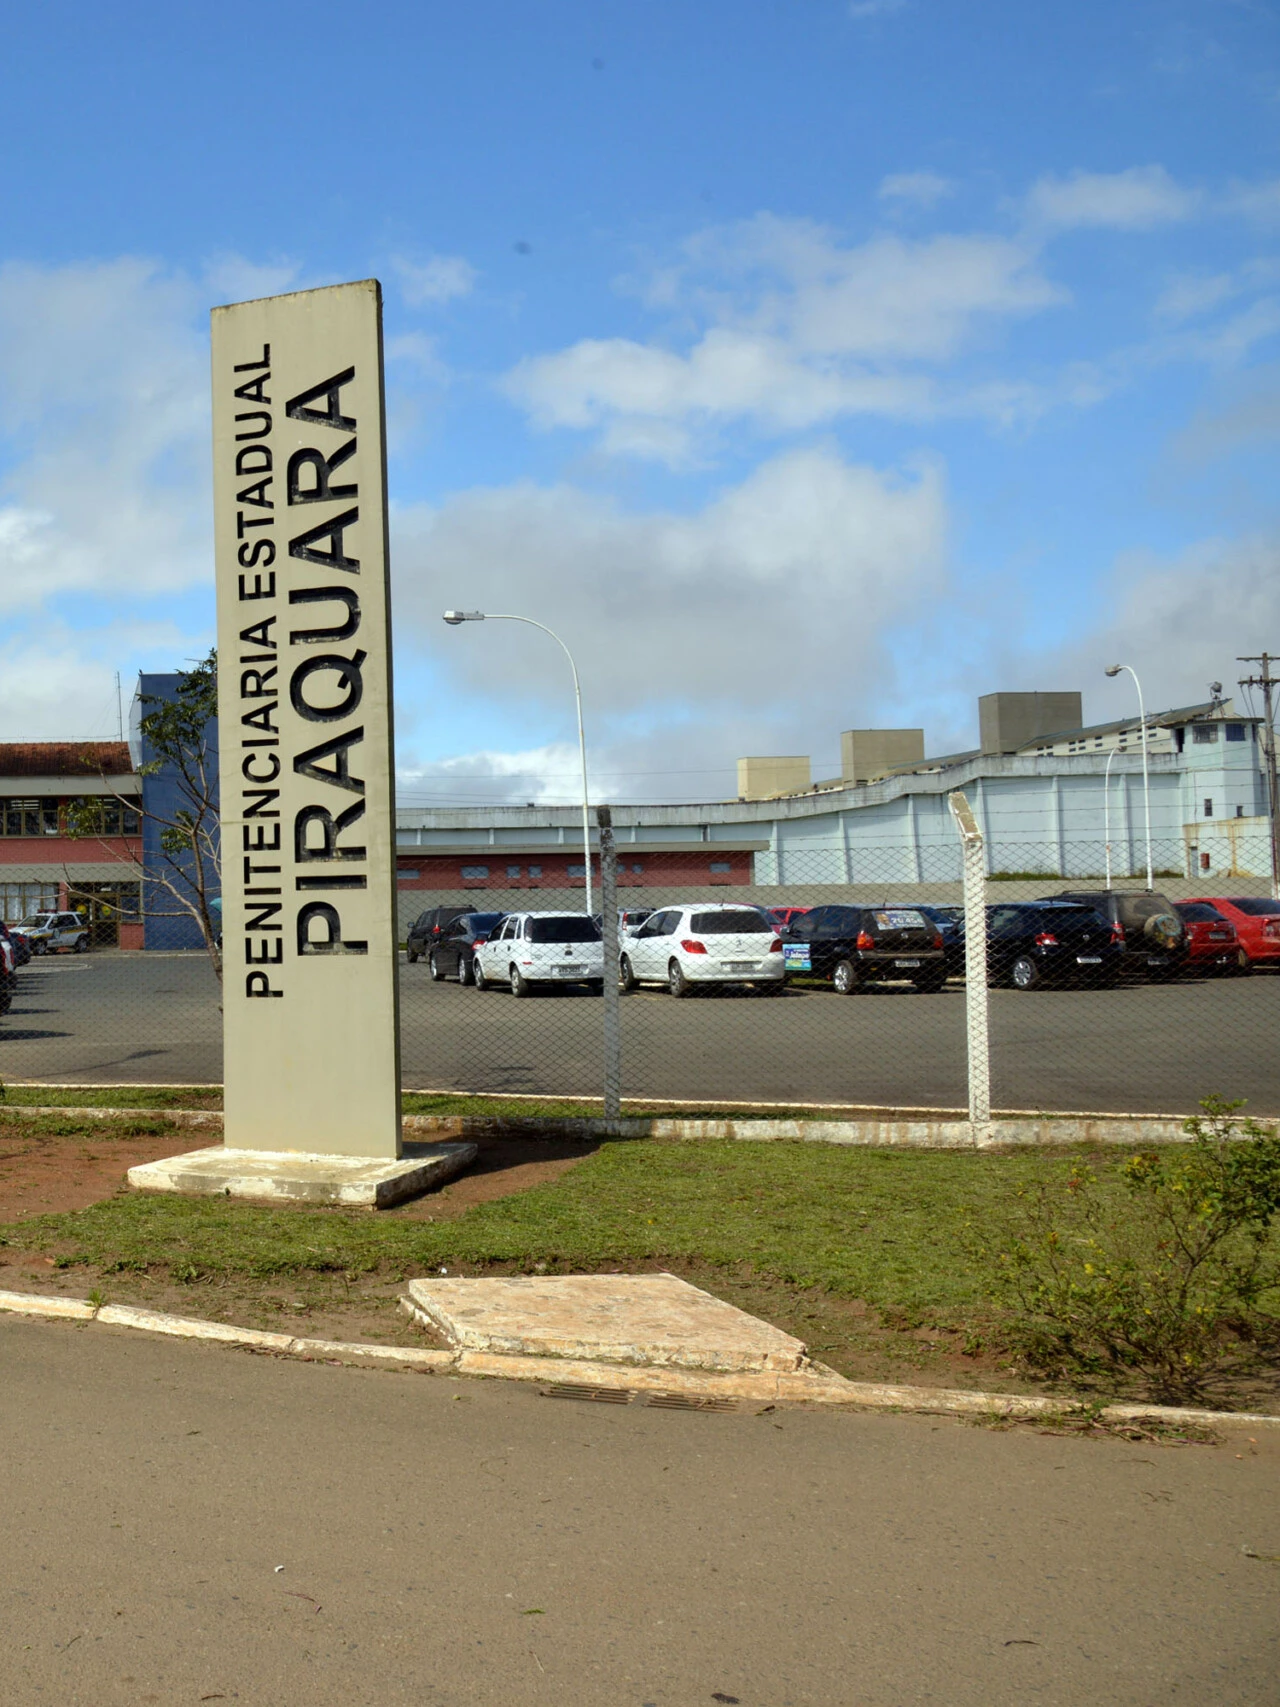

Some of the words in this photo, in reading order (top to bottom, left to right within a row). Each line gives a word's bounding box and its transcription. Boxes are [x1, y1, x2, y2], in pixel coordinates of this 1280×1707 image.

[233, 343, 277, 602] ESTADUAL
[286, 365, 369, 957] PIRAQUARA
[239, 615, 284, 998] PENITENCIARIA
